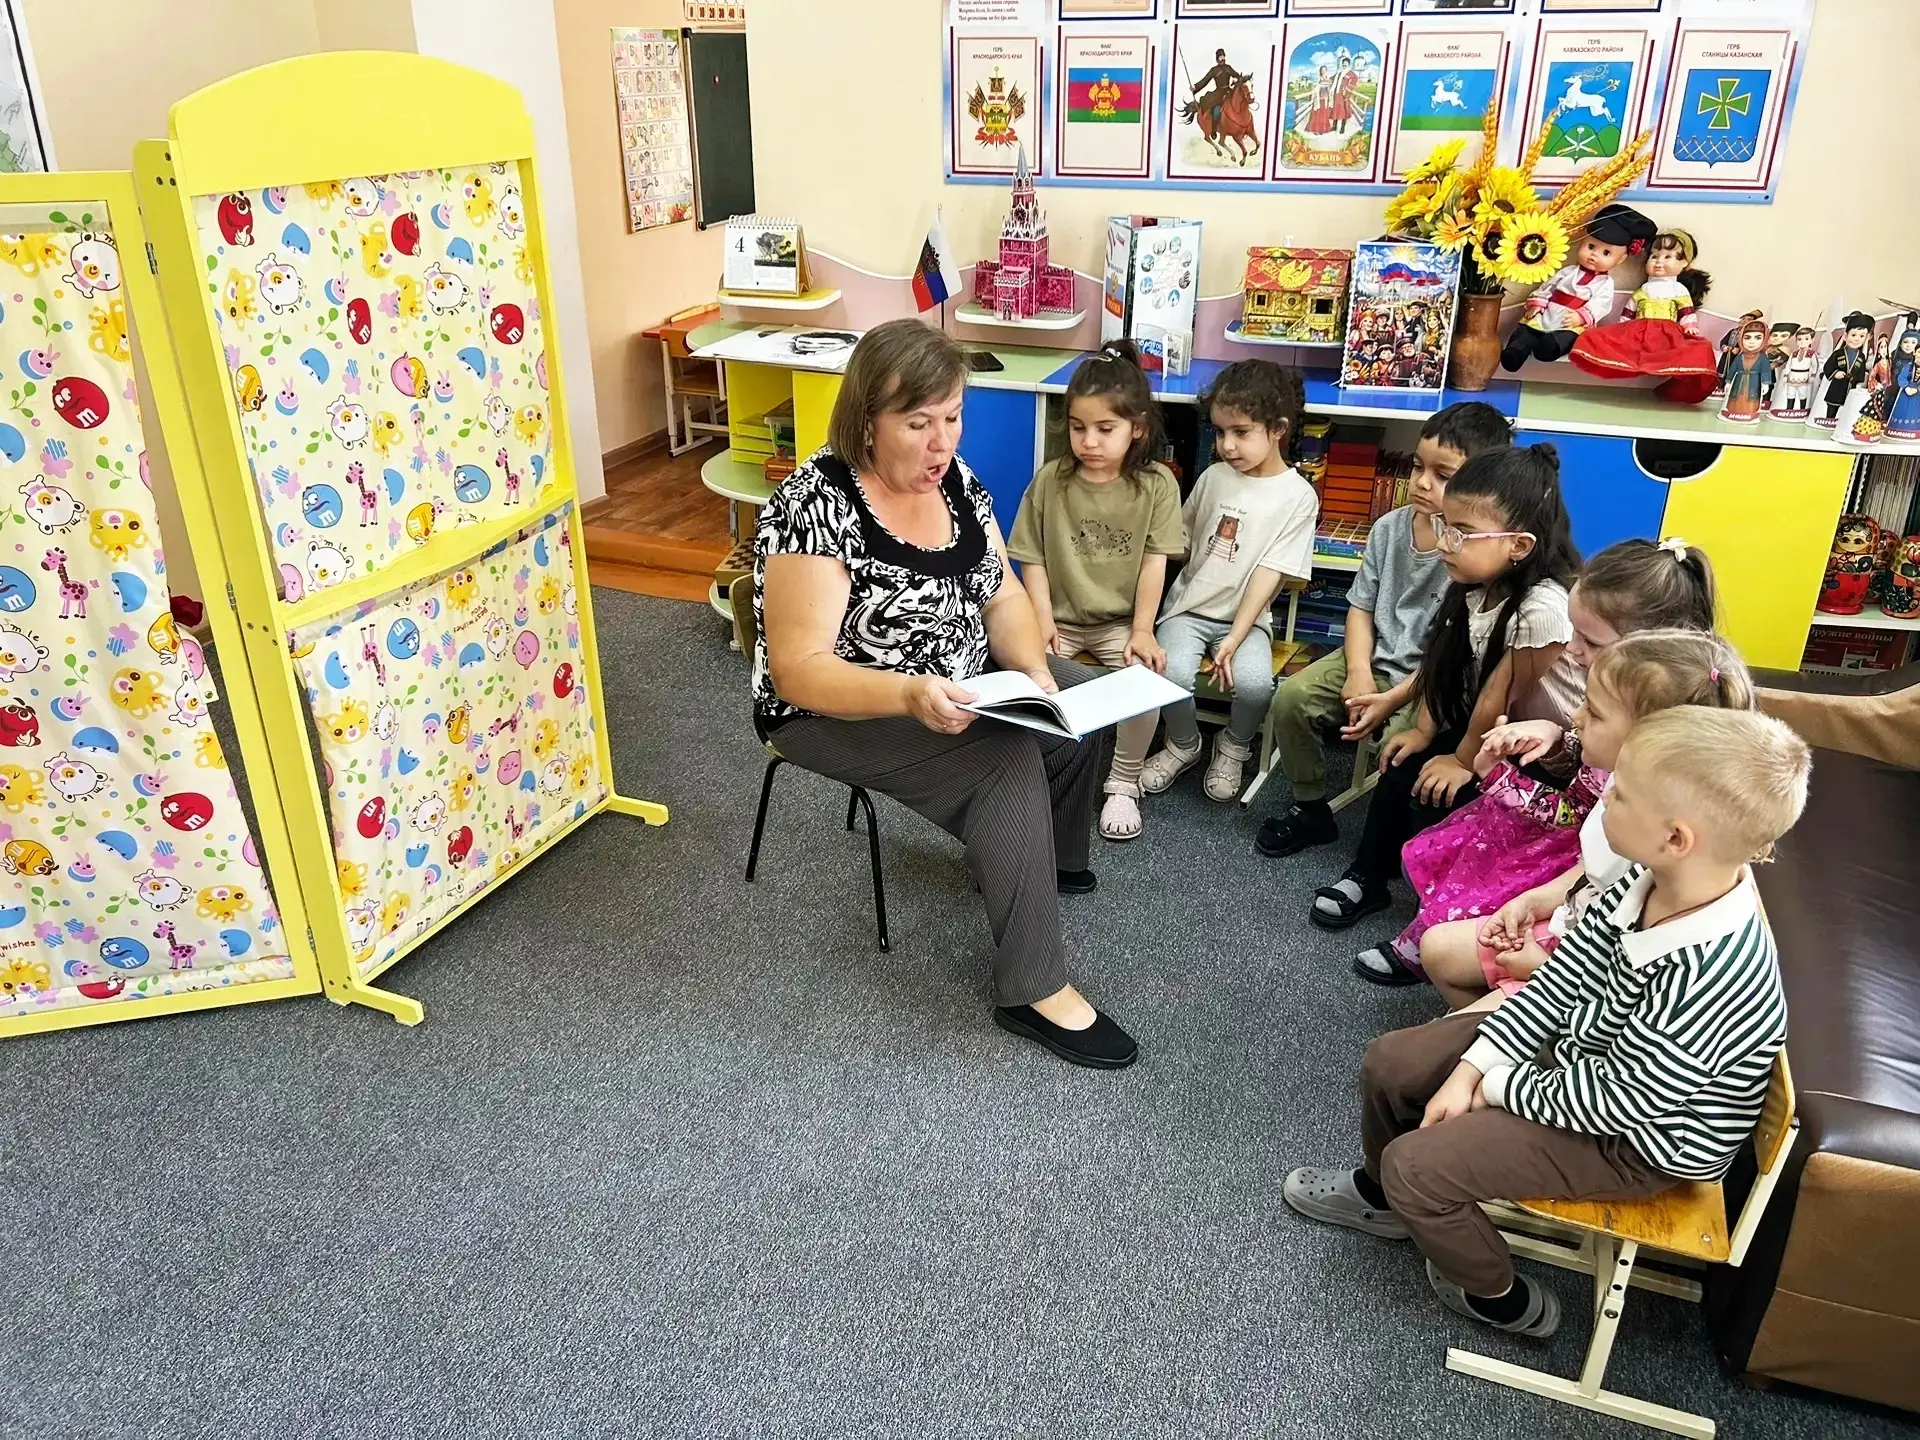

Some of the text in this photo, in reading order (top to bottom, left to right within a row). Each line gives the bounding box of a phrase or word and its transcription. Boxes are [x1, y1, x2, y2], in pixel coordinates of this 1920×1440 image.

[1309, 154, 1340, 162] КУБАНЬ
[734, 236, 744, 252] 4
[1854, 631, 1894, 642] войны
[0, 940, 36, 950] wishes
